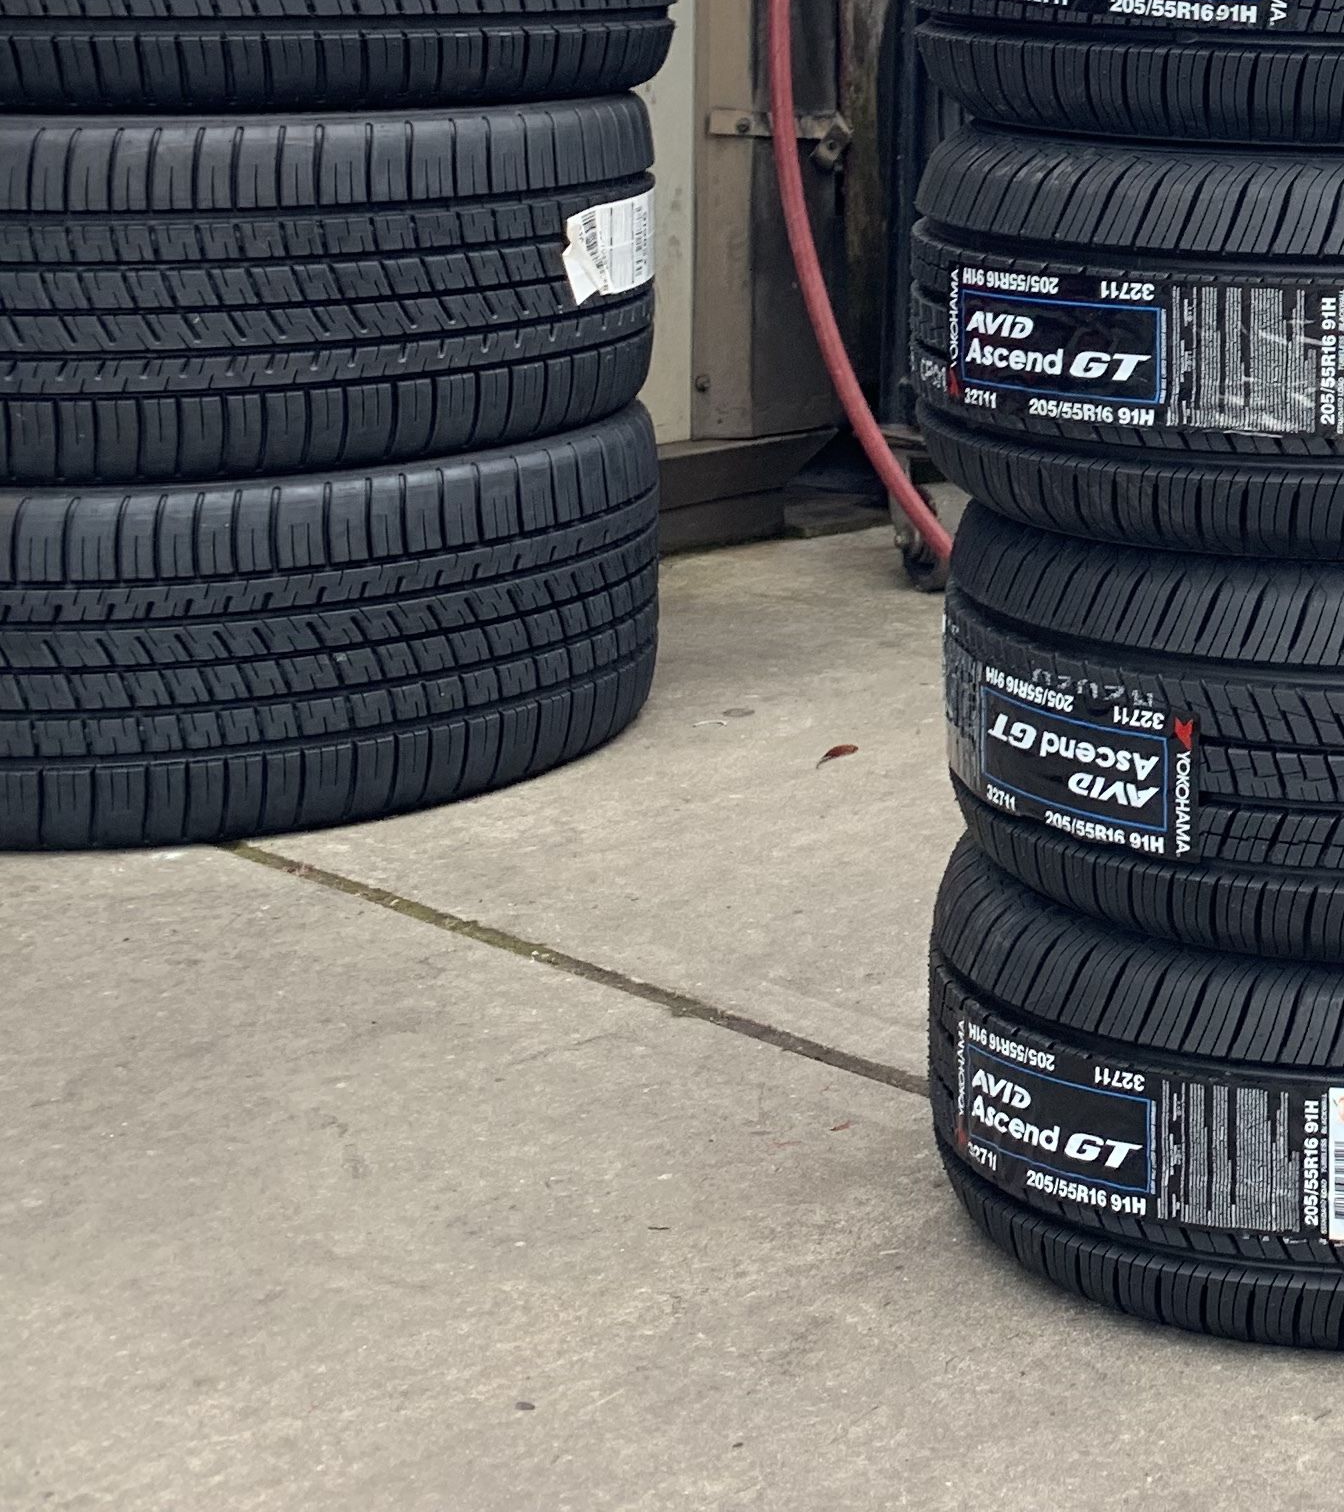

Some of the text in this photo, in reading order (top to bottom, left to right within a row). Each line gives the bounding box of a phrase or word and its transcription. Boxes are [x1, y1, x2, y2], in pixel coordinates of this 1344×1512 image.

[1214, 3, 1257, 23] 91H
[962, 267, 1060, 294] 205/55R16 91H
[1100, 281, 1155, 300] 32711
[965, 310, 1034, 340] AVID
[965, 340, 1152, 383] Ascend GT
[1320, 296, 1337, 425] 205/55R16 91H
[964, 388, 1155, 426] 32711 205/55R16 91H
[985, 666, 1074, 713] 205/55R16 91H
[1113, 705, 1165, 730] 32711
[987, 713, 1160, 782] Ascend GT
[1067, 772, 1161, 809] AVID
[1175, 749, 1192, 855] YOKOHAMA
[986, 784, 1165, 854] 32711 205/55R16 91H
[968, 1023, 1055, 1071] 205/55R16 91H
[971, 1068, 1032, 1112] AVID
[1094, 1066, 1146, 1091] 32711
[971, 1099, 1143, 1172] Ascend GT
[1304, 1100, 1319, 1226] 205/55R16 91H
[1026, 1170, 1108, 1209] 205/55R16
[1110, 1192, 1148, 1216] 91H
